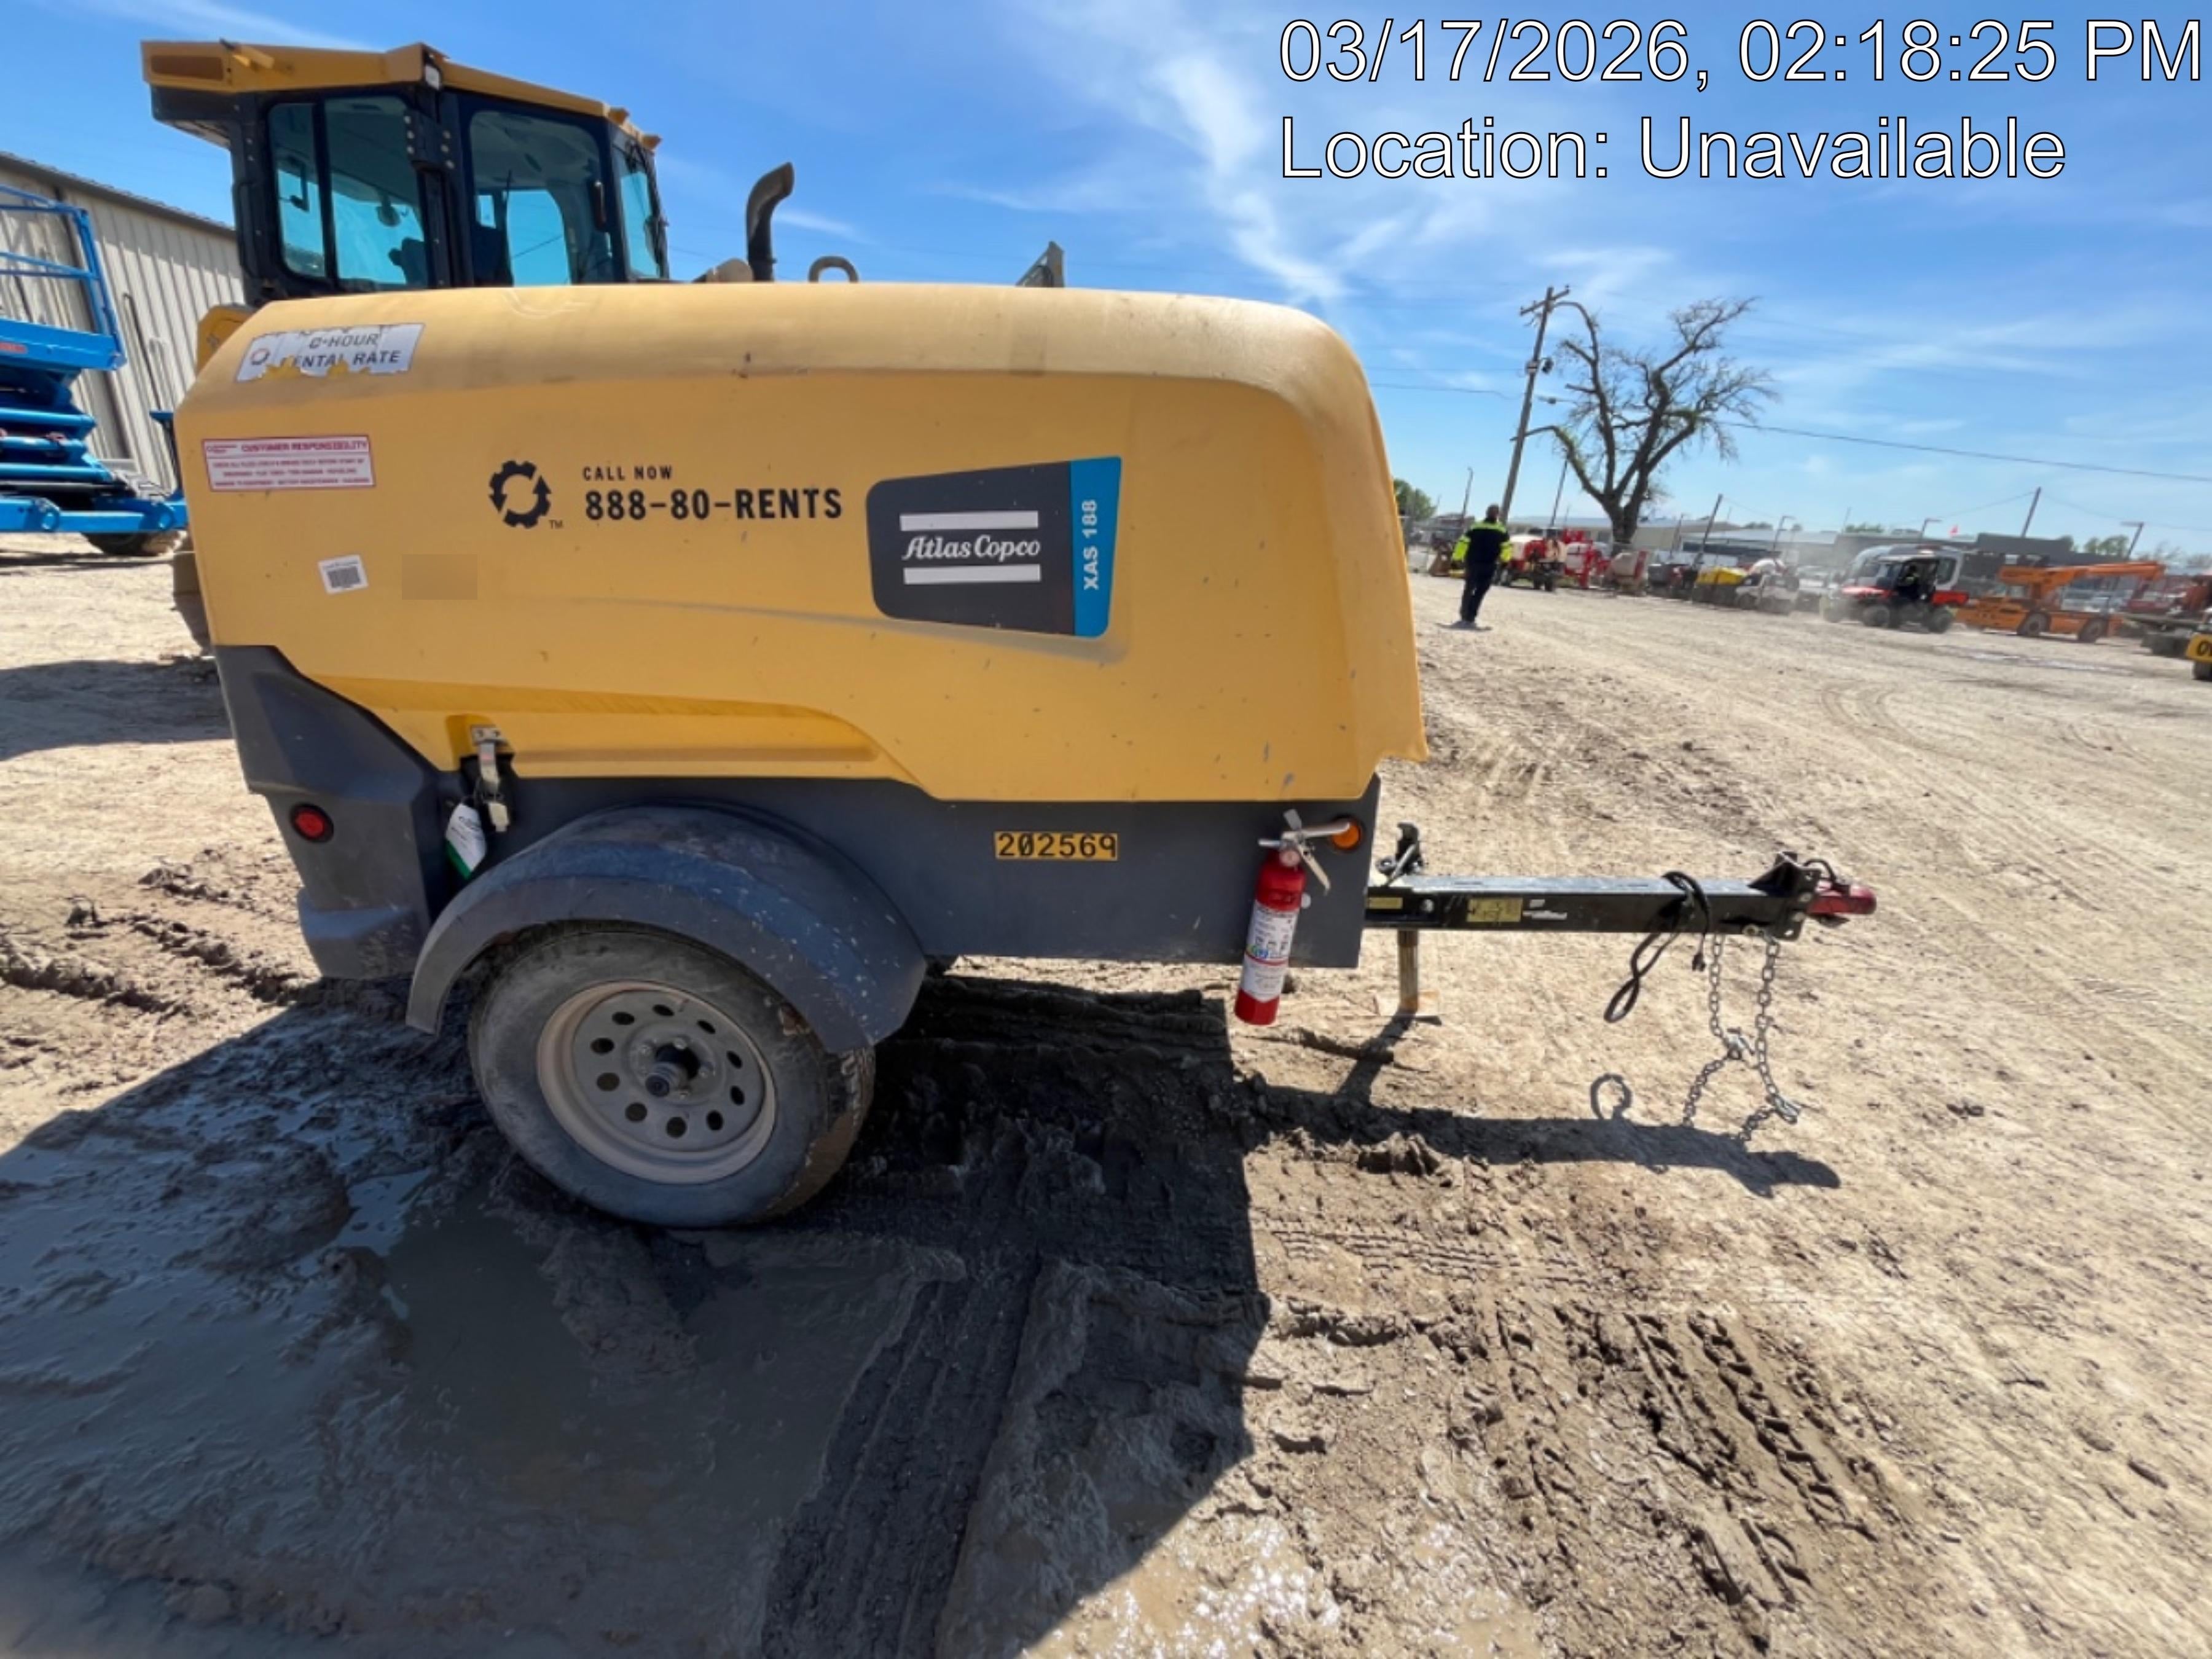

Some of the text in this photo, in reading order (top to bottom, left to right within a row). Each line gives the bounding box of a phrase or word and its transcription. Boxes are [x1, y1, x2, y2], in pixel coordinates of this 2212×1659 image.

[352, 350, 401, 366] RATE
[582, 465, 672, 481] CALL NOW
[586, 488, 842, 520] 888-80-RENTS
[901, 534, 1041, 562] Atlas Copco
[1081, 500, 1099, 590] XAS 188
[998, 833, 1116, 857] 202569
